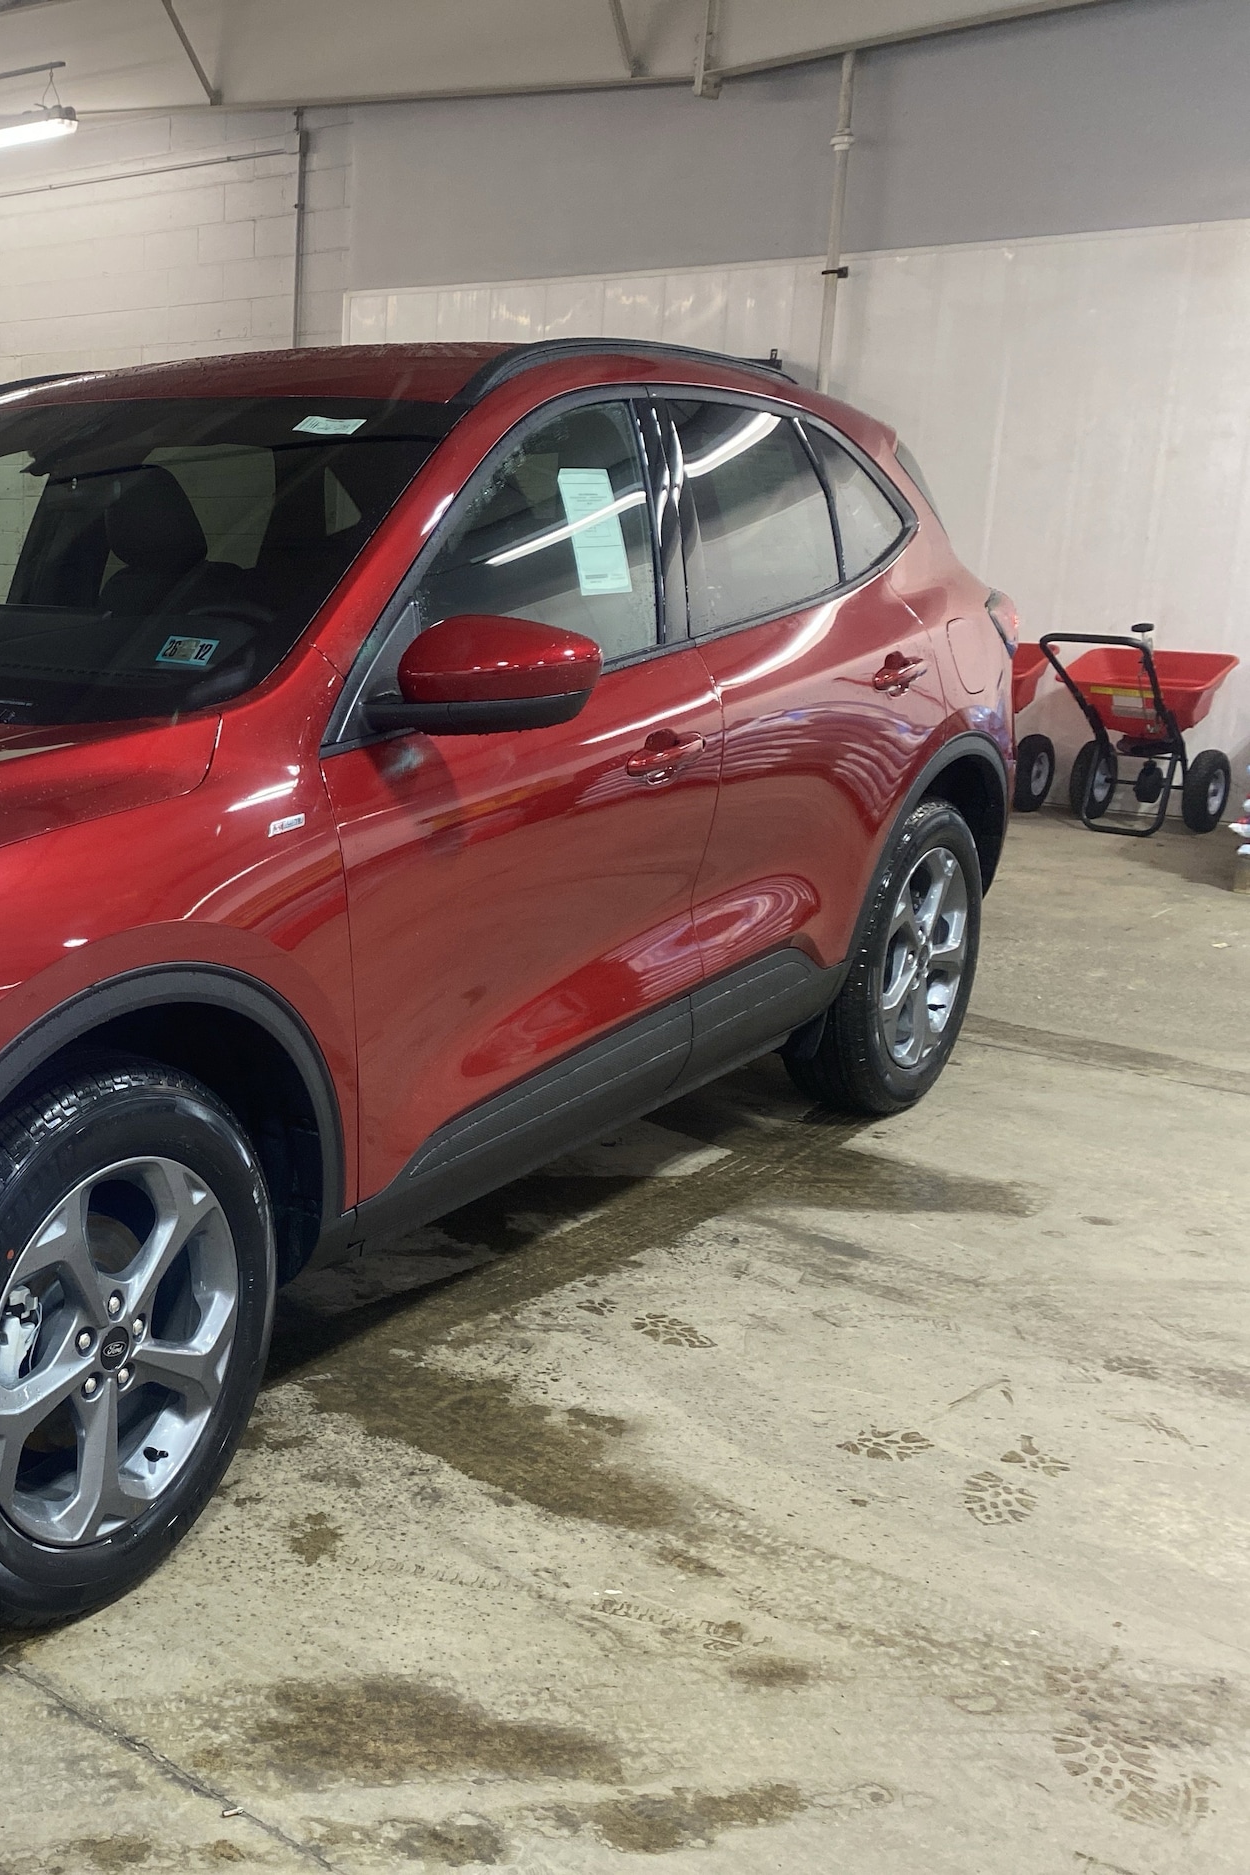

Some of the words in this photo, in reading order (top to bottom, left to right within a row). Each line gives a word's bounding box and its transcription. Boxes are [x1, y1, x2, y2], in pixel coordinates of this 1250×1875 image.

[161, 639, 182, 657] 26
[193, 642, 213, 661] 12
[106, 1343, 124, 1355] Ford
